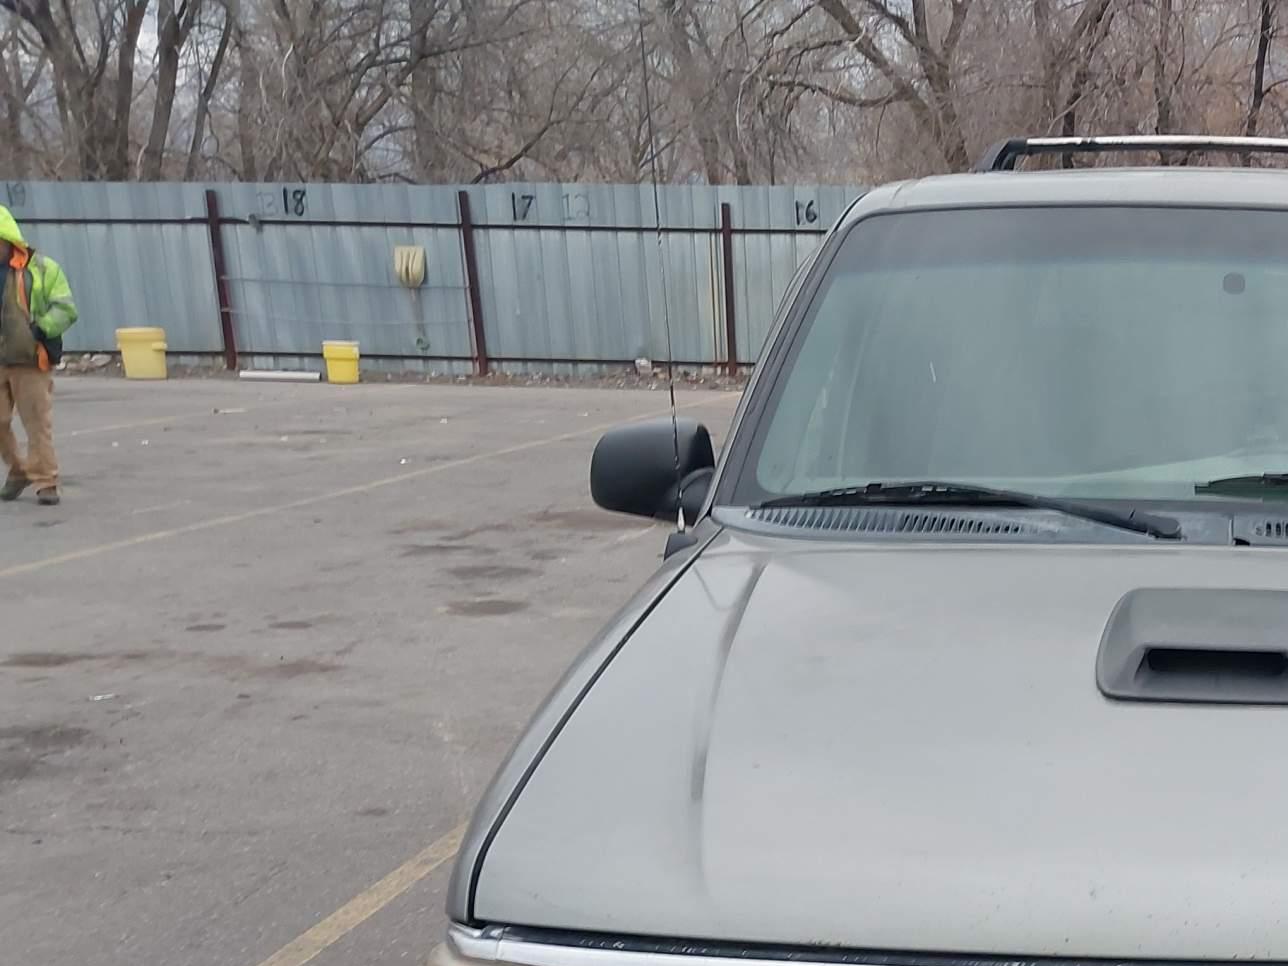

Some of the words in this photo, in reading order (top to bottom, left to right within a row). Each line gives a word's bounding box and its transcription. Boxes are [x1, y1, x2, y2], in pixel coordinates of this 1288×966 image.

[282, 186, 307, 217] 18
[511, 191, 536, 222] 17
[795, 199, 818, 226] 16
